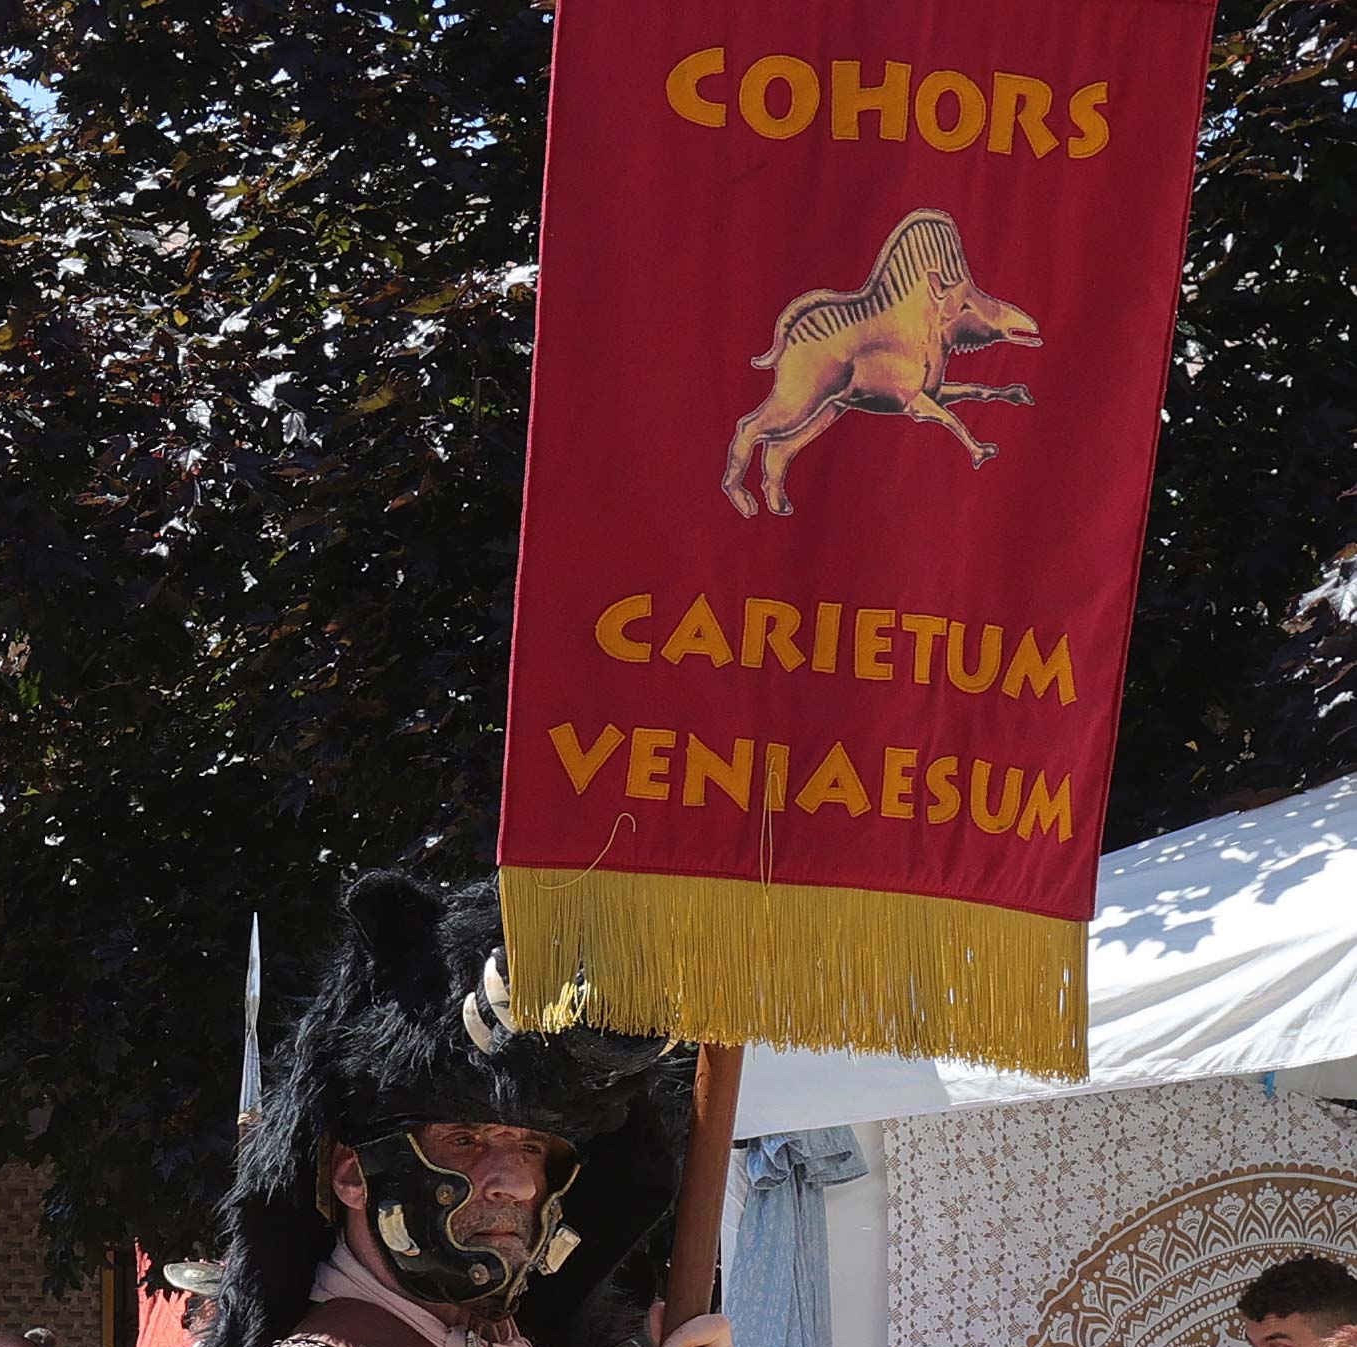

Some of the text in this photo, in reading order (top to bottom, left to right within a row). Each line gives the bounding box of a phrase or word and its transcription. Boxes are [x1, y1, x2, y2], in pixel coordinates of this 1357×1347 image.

[666, 48, 1109, 159] COHORS
[594, 593, 1077, 706] CARIETUM
[548, 722, 1073, 843] VENIAESUM
